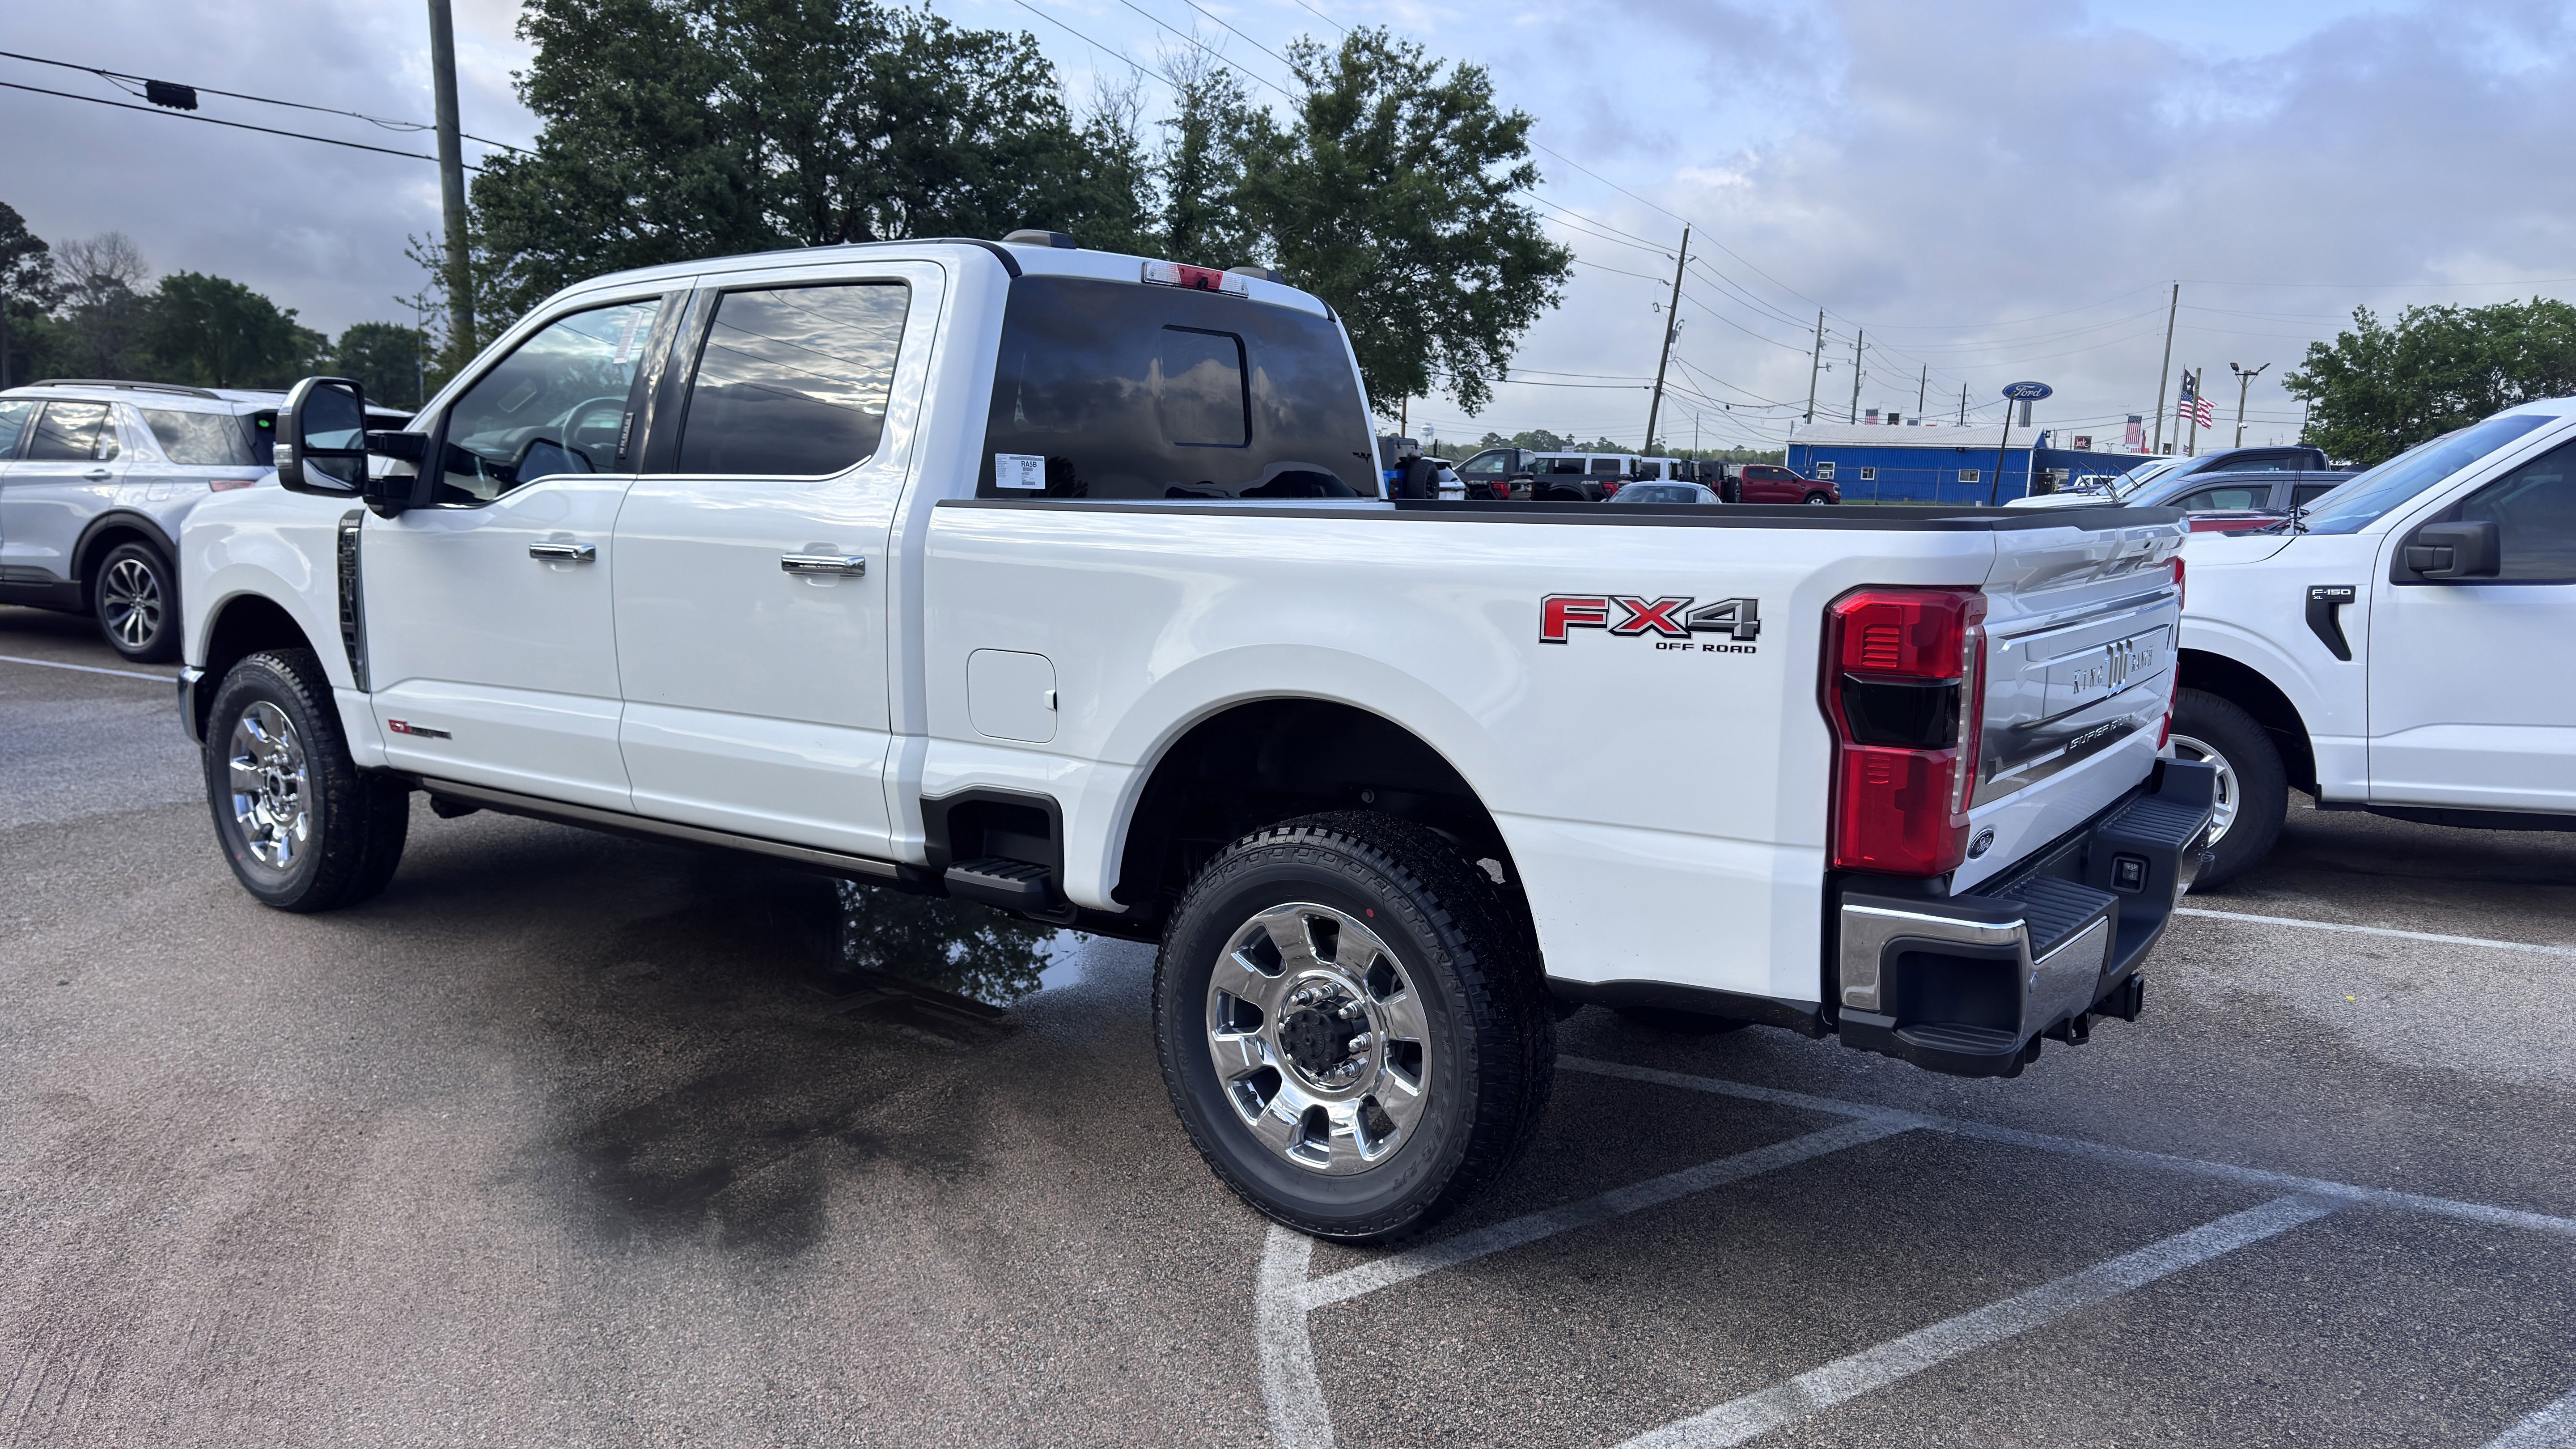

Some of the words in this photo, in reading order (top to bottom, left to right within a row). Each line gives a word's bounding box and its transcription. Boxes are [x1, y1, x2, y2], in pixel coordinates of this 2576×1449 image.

[2014, 385, 2042, 397] Ford
[2075, 438, 2090, 448] Jack
[1538, 592, 1762, 644] FX4
[1656, 642, 1694, 651] OFF
[1702, 644, 1757, 654] ROAD
[2073, 665, 2103, 695] KING
[2131, 645, 2153, 673] RANCH
[2070, 724, 2110, 750] SUPER
